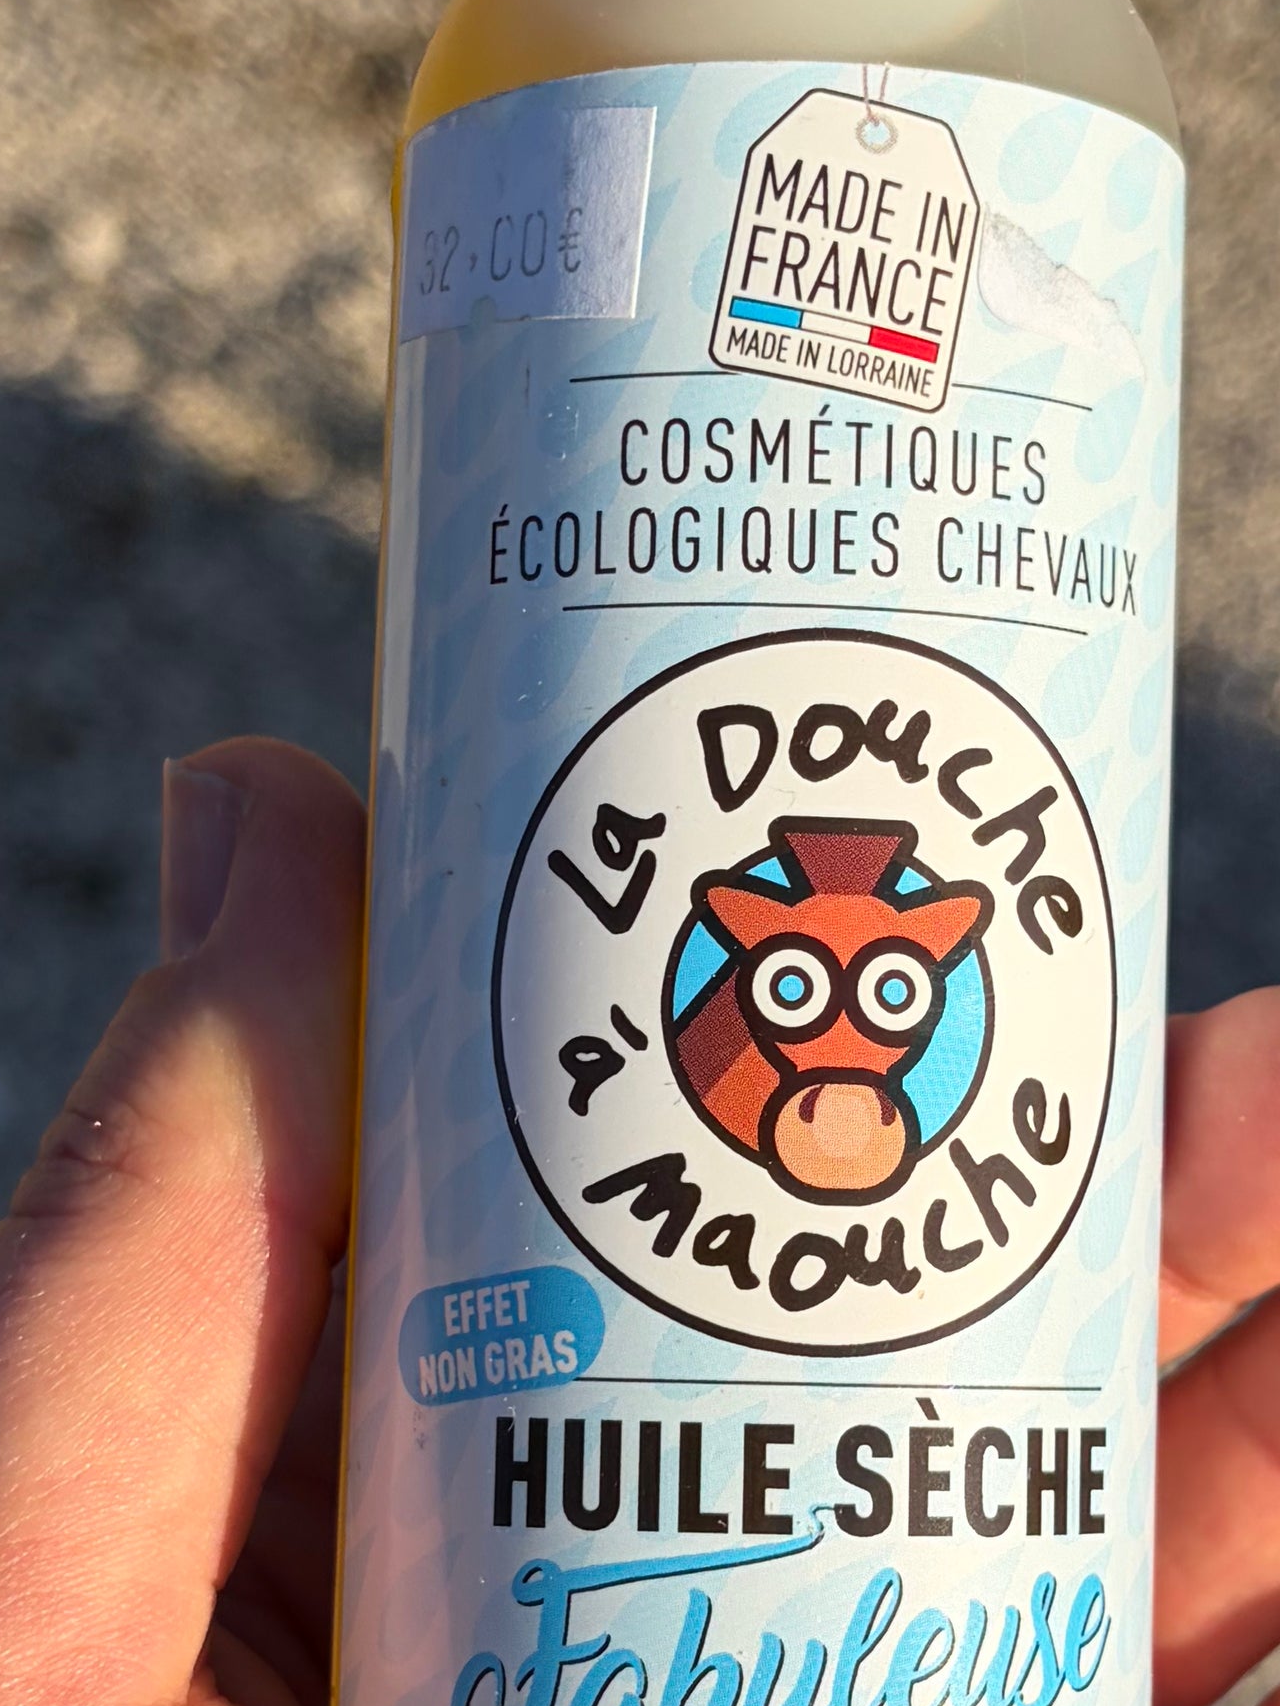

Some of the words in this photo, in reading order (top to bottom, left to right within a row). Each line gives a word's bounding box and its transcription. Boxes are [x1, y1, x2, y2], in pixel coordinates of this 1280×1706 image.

[753, 151, 902, 247] MADE
[917, 192, 968, 263] IN
[739, 225, 956, 335] FRANCE
[726, 325, 791, 364] MADE
[796, 338, 821, 370] IN
[825, 344, 937, 399] LORRAINE
[620, 404, 1047, 506] COSMÉTIQUES
[488, 504, 901, 585] ÉCOLOGIQUES
[936, 516, 1138, 617] CHEVAUX
[443, 1280, 530, 1340] EFFET
[418, 1349, 478, 1397] NON
[485, 1330, 579, 1386] GRAS
[492, 1416, 795, 1536] HUILE
[834, 1398, 1106, 1537] SÈCHE
